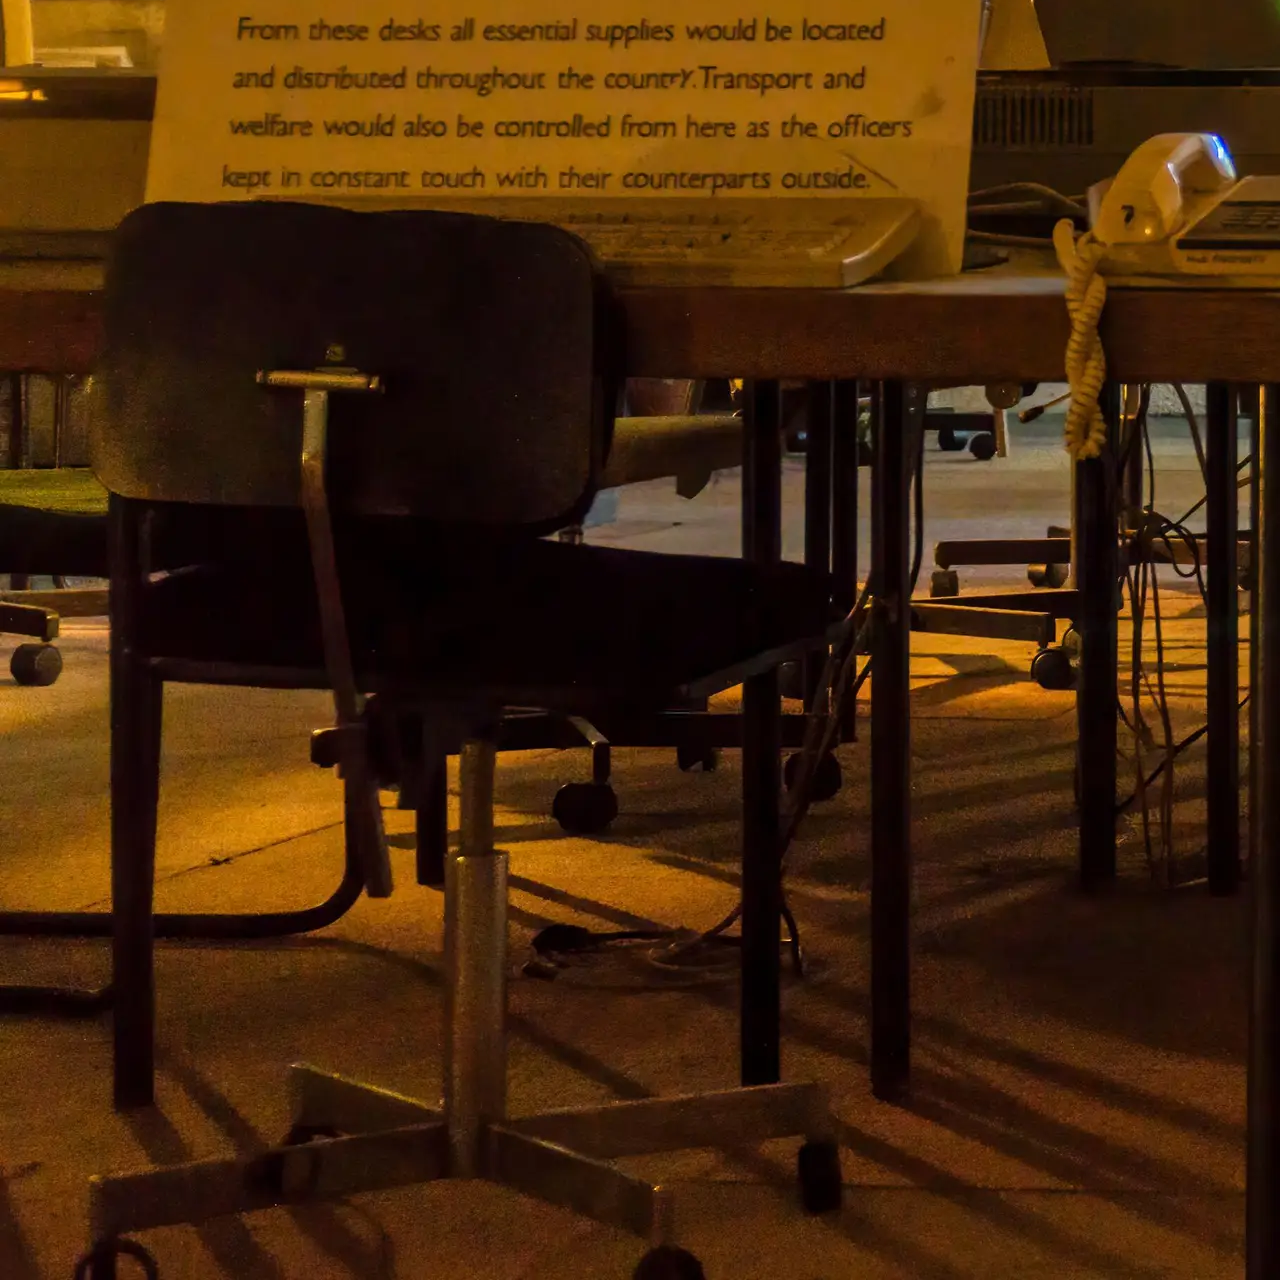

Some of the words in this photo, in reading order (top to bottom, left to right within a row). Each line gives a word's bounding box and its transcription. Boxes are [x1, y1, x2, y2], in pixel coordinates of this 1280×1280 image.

[237, 17, 299, 41] From
[308, 18, 369, 41] these
[379, 17, 442, 41] desks
[450, 18, 475, 41] all
[482, 17, 577, 42] essential
[585, 19, 675, 48] supplies
[686, 18, 757, 41] would
[765, 18, 793, 41] be
[802, 17, 886, 41] located
[232, 66, 275, 89] and
[284, 65, 406, 89] distributed
[416, 66, 546, 97] throughout
[558, 66, 594, 89] the
[823, 66, 866, 90] and
[229, 113, 313, 137] welfare
[323, 113, 396, 137] would
[403, 114, 447, 138] also
[456, 114, 484, 138] be
[494, 114, 610, 138] controlled
[620, 114, 676, 138] from
[686, 114, 736, 138] here
[746, 121, 770, 138] as
[781, 115, 818, 138] the
[827, 114, 912, 138] officers
[221, 165, 271, 193] kept
[281, 166, 300, 188] in
[310, 168, 409, 188] constant
[421, 165, 485, 188] touch
[496, 166, 547, 189] with
[558, 166, 611, 189] their
[622, 168, 771, 195] counterparts
[781, 166, 871, 189] outside.
